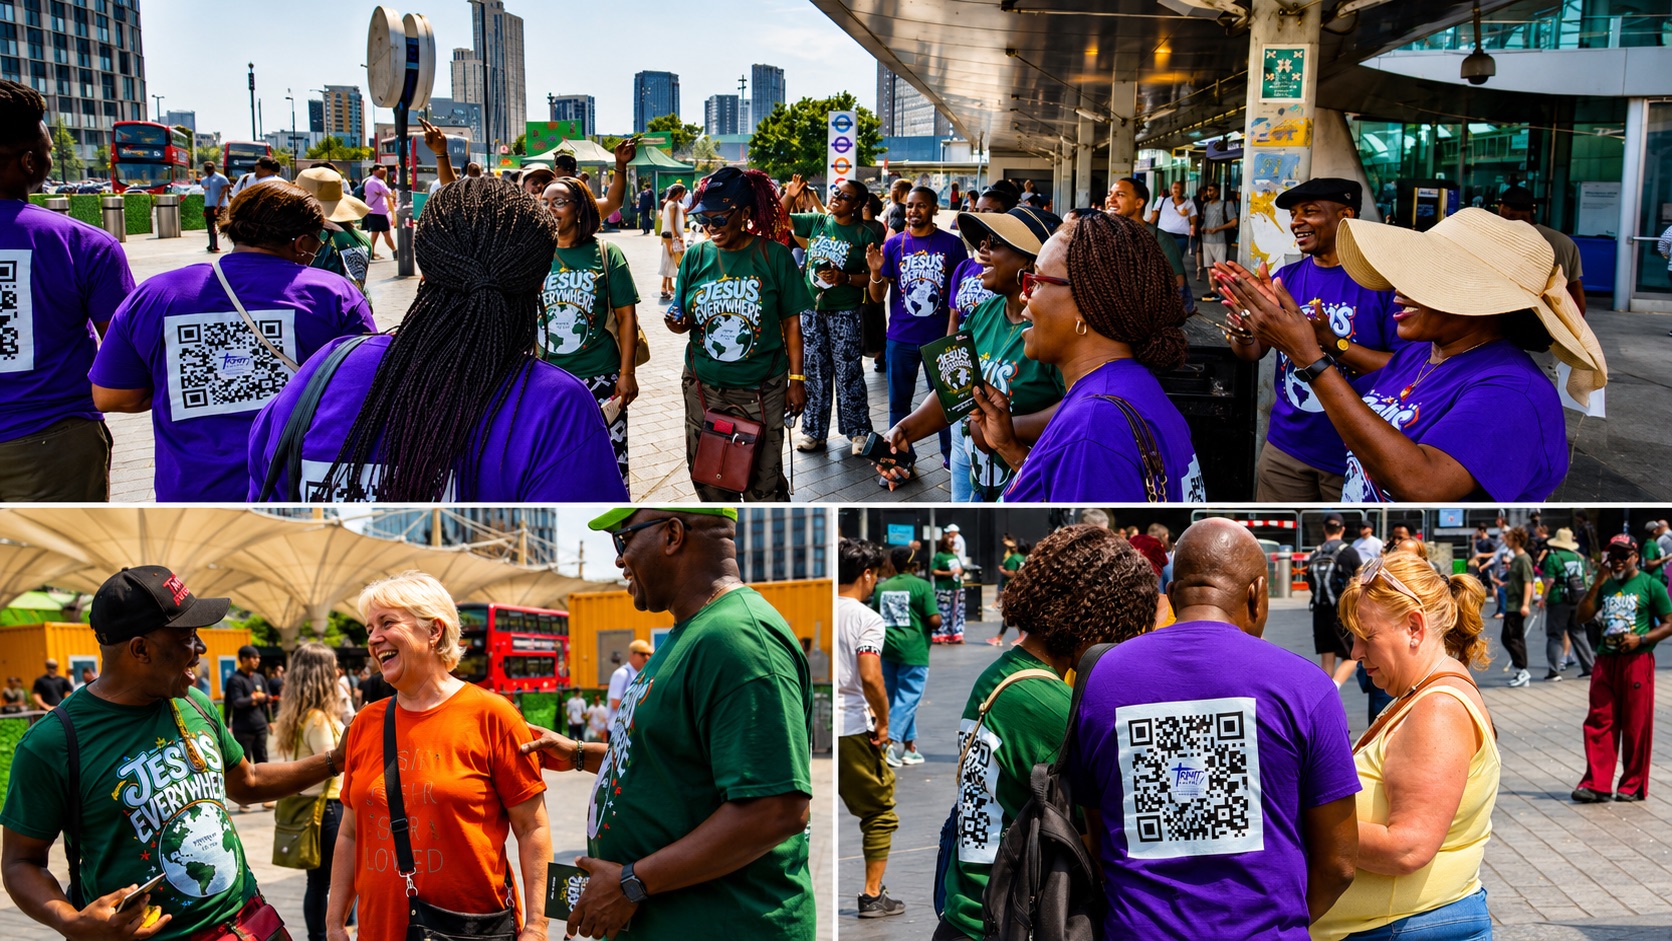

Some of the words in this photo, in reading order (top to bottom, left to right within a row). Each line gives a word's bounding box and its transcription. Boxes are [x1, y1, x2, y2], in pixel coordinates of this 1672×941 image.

[900, 253, 945, 273] JESUS
[543, 271, 597, 292] ESUS
[695, 278, 760, 305] JESUS
[541, 288, 597, 314] ERYWHERE
[694, 297, 763, 326] EVERYWHERE
[937, 346, 970, 371] JESUS
[117, 733, 224, 808] JESUS
[129, 771, 230, 844] EVERYWHER
